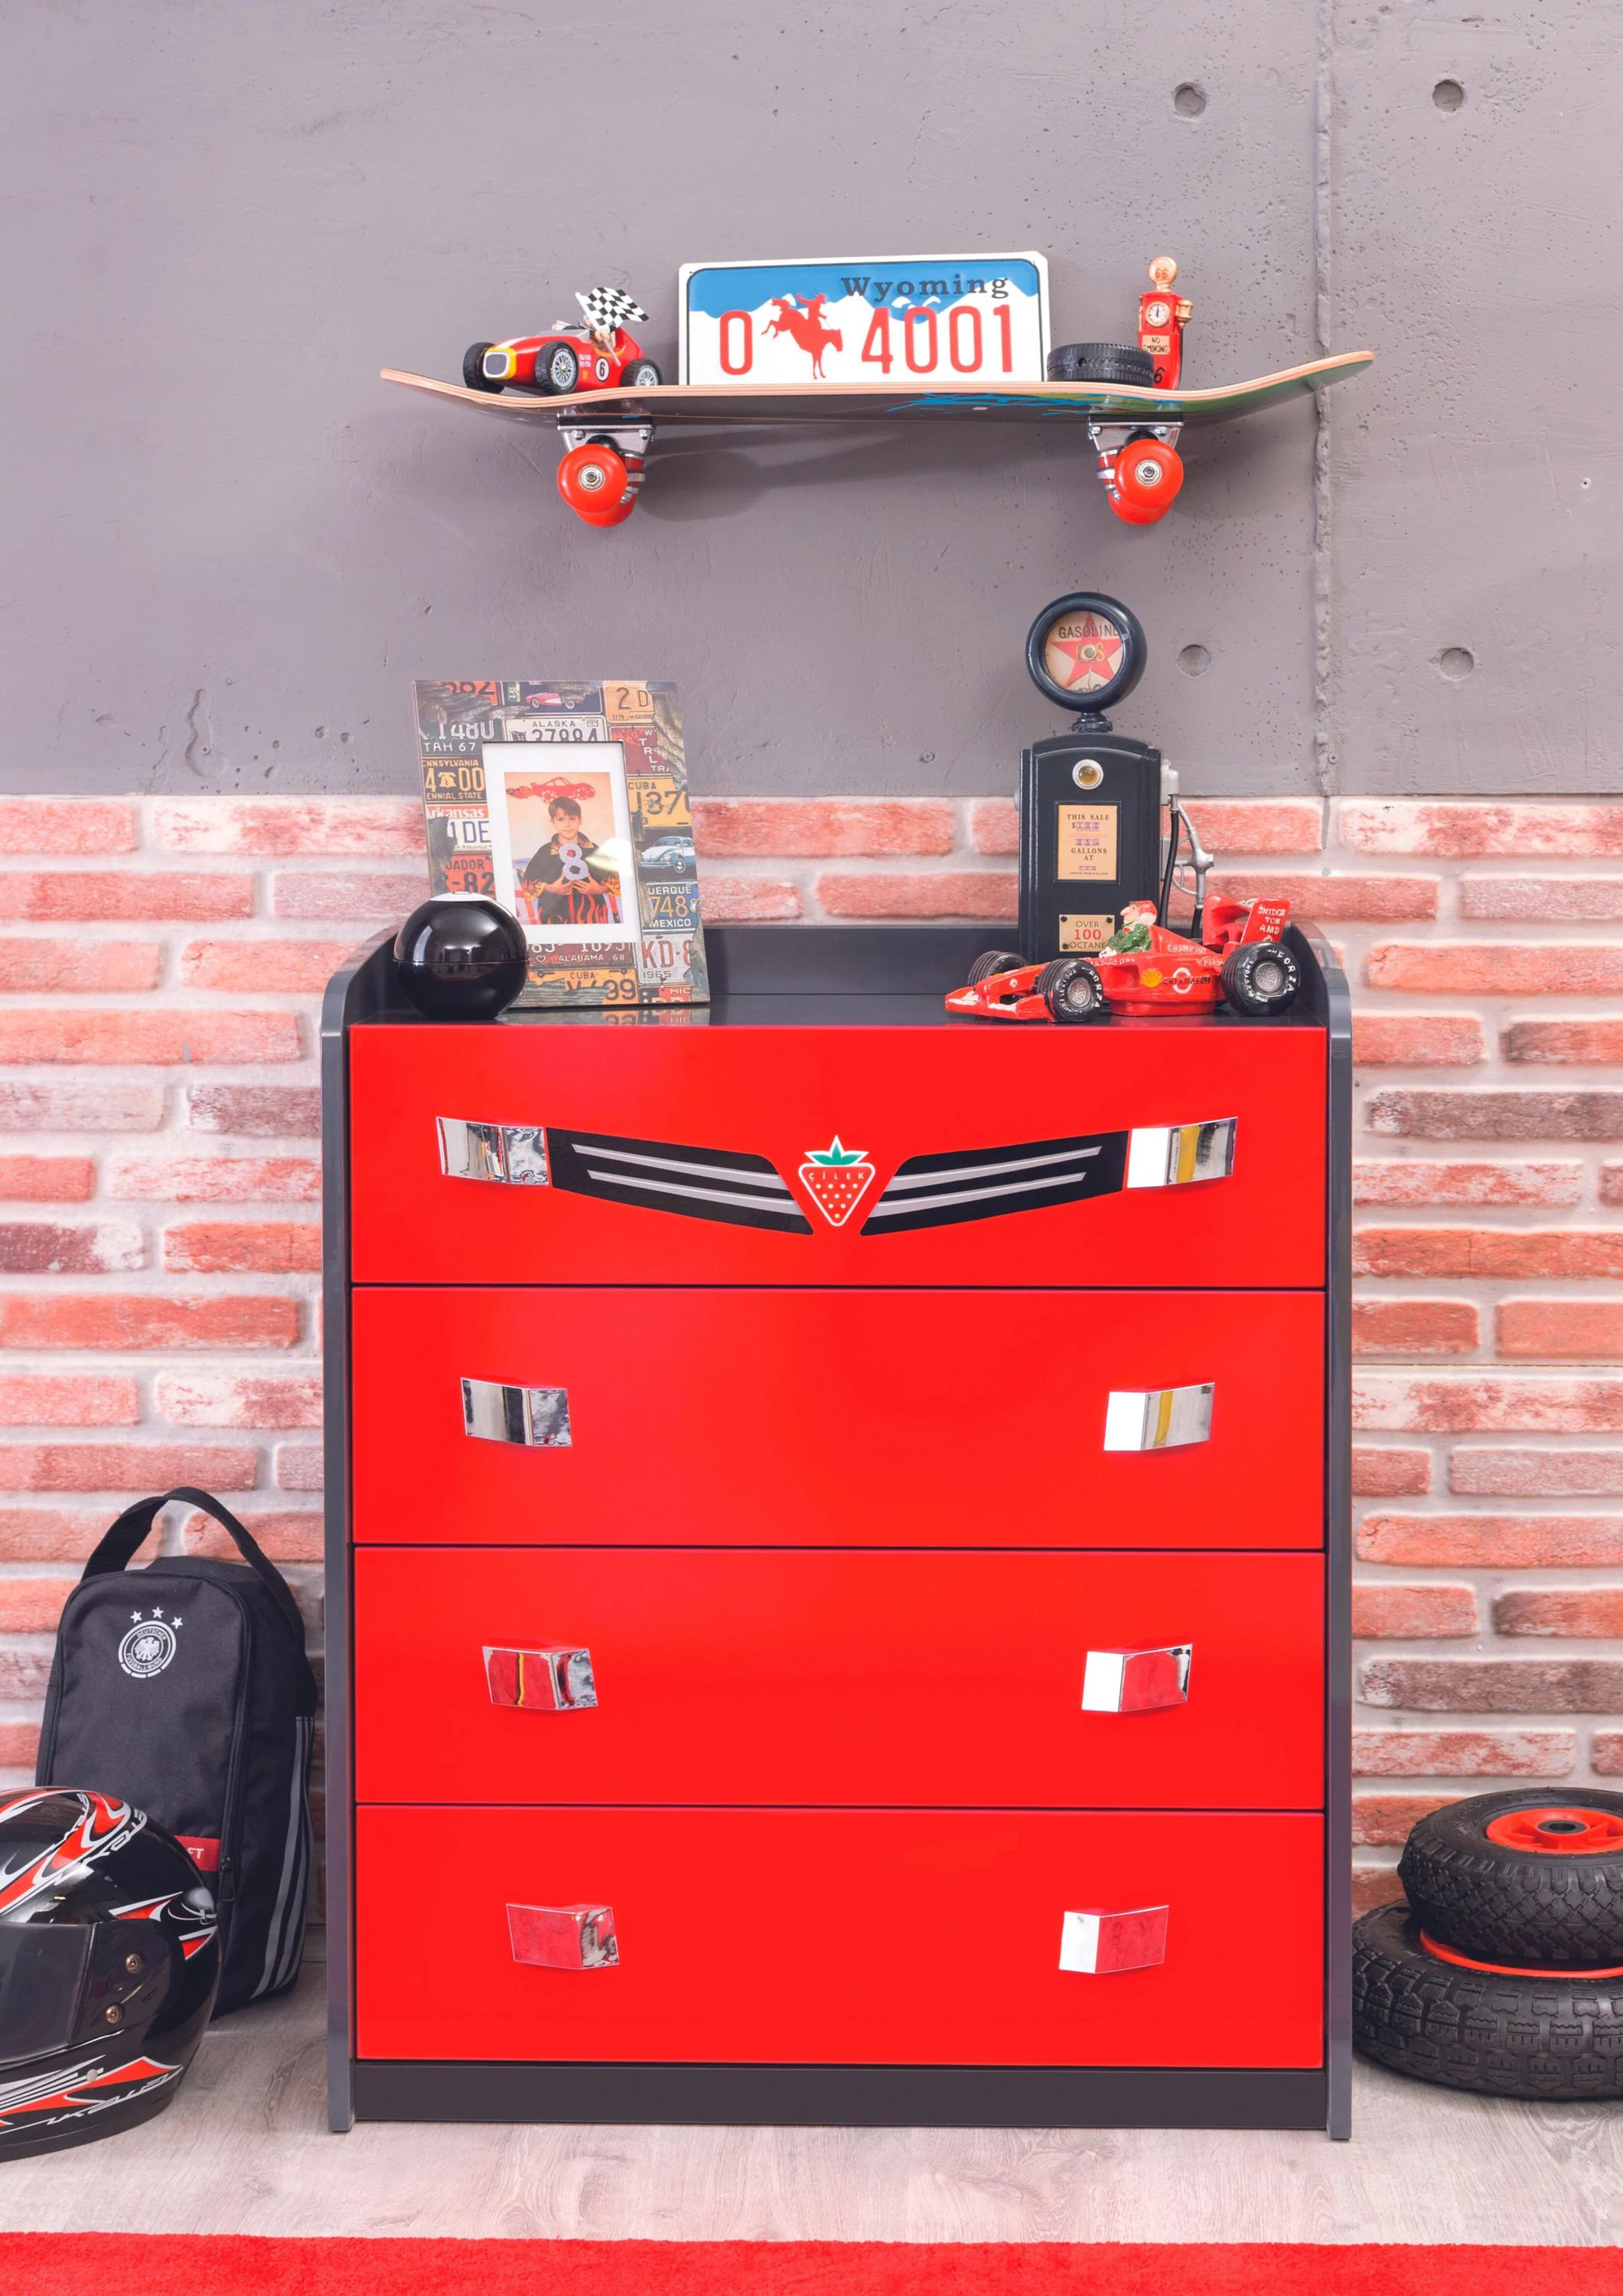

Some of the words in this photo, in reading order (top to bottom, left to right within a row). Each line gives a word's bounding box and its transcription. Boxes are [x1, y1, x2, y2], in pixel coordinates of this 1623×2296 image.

[842, 273, 1009, 302] Wyoming
[861, 305, 1012, 373] 4001
[599, 361, 605, 377] 6
[423, 742, 452, 752] TAH
[459, 742, 475, 752] 67
[628, 781, 657, 790] CUBA
[650, 918, 692, 928] MEXICO
[1074, 929, 1102, 940] 100
[809, 1171, 864, 1182] ÇİLEK
[137, 1629, 167, 1640] DEUTSCHER
